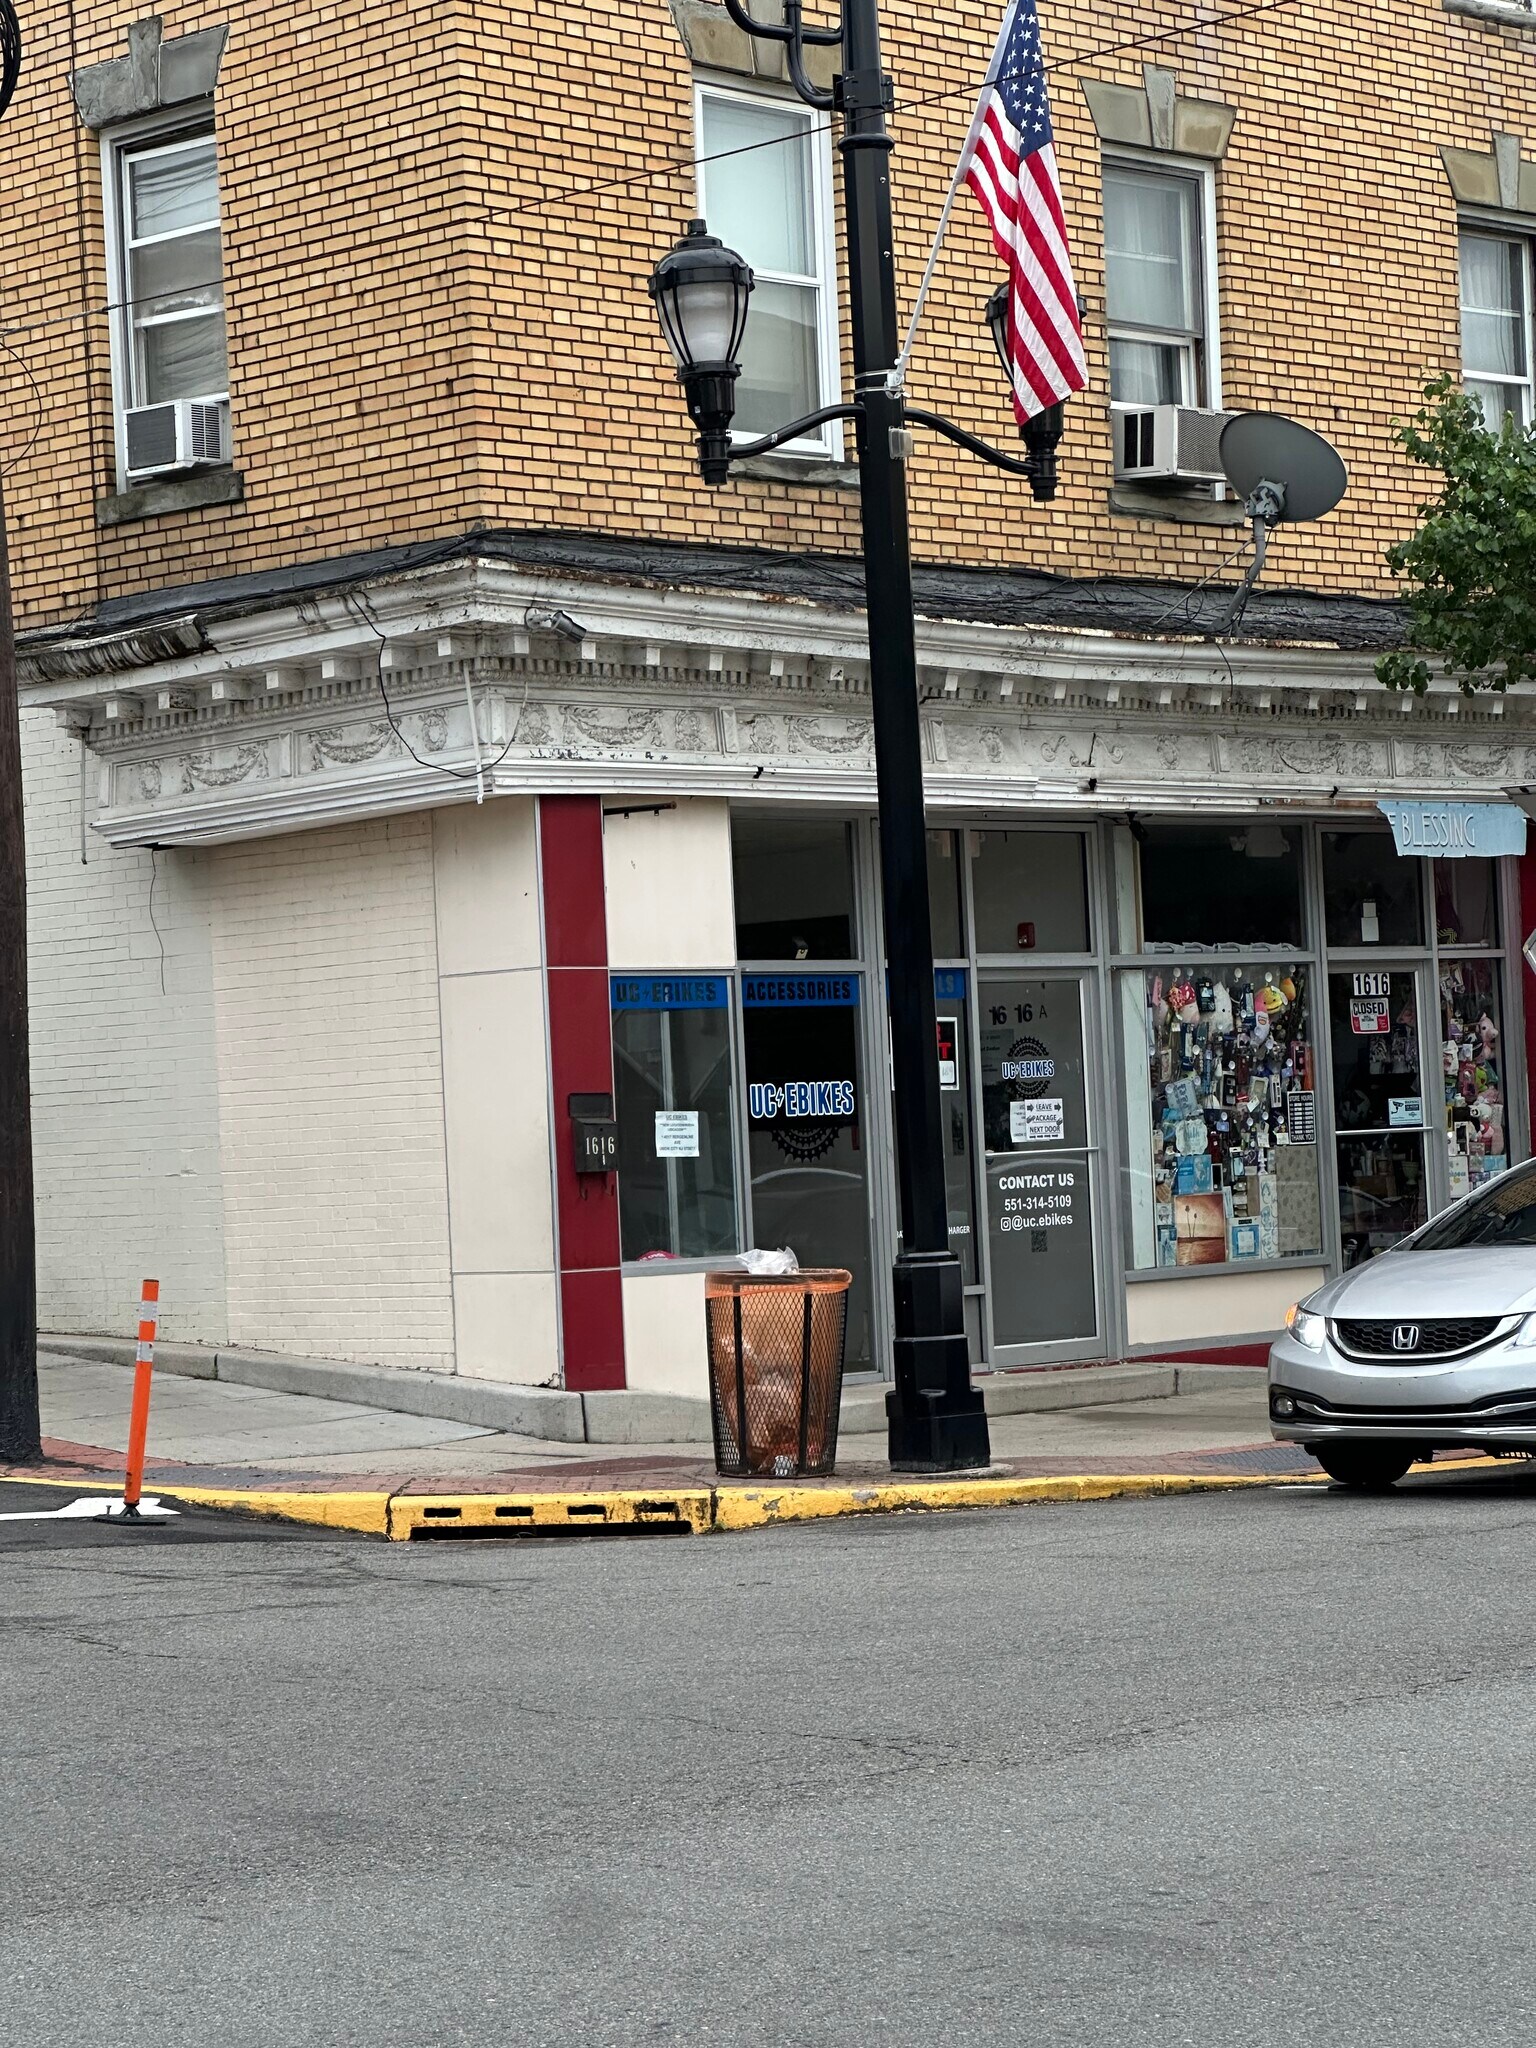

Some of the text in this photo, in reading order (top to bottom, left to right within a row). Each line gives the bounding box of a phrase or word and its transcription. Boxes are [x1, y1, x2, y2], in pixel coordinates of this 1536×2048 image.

[1401, 812, 1476, 848] BLESSING
[616, 981, 717, 1003] UC EBIKES
[747, 981, 851, 1000] ACCESSORIES
[1355, 973, 1389, 995] 1616
[1039, 1005, 1048, 1018] A
[1353, 1002, 1385, 1015] CLOSED
[1002, 1062, 1018, 1079] UC
[1020, 1060, 1054, 1078] EBIKES
[750, 1081, 854, 1118] UC EBIKES
[1035, 1103, 1053, 1111] LEAVE
[1032, 1114, 1057, 1122] PACKAGE
[1044, 1125, 1061, 1133] DOOR
[585, 1136, 615, 1155] 1616
[999, 1172, 1075, 1190] CONTACT US
[1004, 1194, 1072, 1211] 551-314-5109
[948, 1225, 971, 1235] HARGER
[1011, 1212, 1073, 1231] @uc.ebikes
